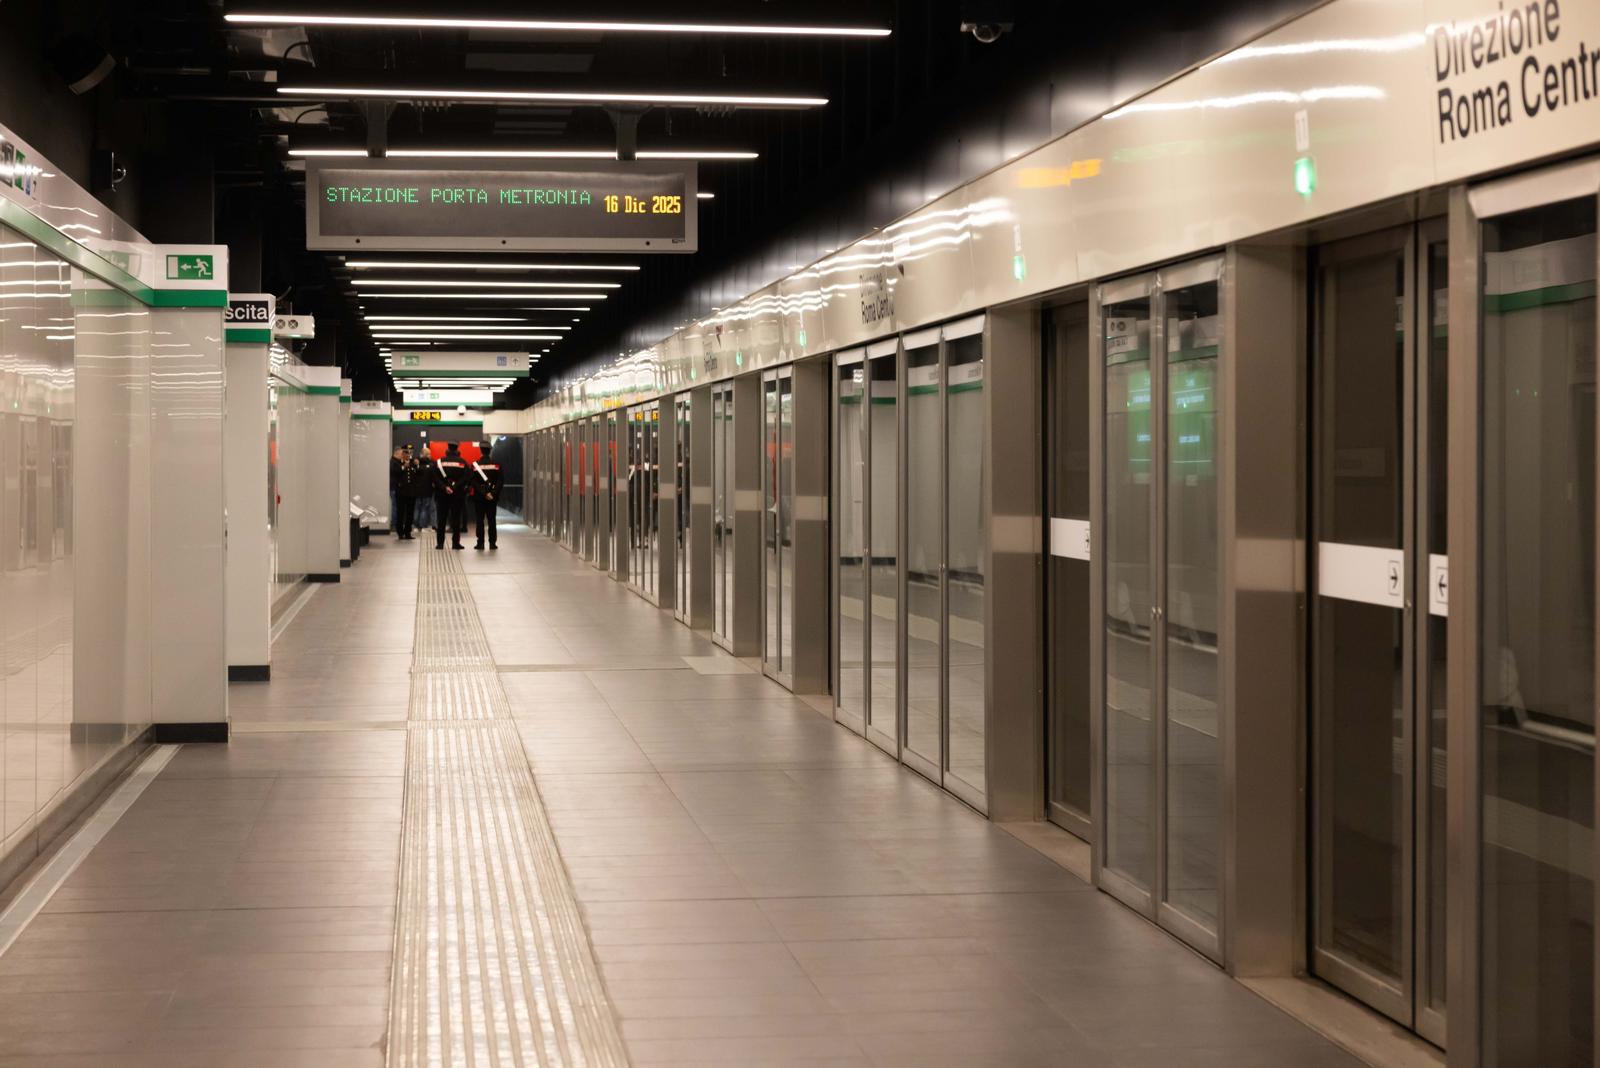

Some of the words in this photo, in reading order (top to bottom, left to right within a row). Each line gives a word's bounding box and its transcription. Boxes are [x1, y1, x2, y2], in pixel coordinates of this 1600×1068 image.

[1434, 0, 1560, 82] Direzione
[1438, 80, 1512, 143] Roma
[1521, 42, 1600, 117] Centr
[326, 187, 419, 203] STAZIONE
[431, 188, 488, 204] PORTA
[499, 189, 591, 205] METRONIA
[603, 195, 619, 213] 16
[625, 195, 646, 213] Dic
[652, 195, 681, 214] 2025
[225, 304, 268, 320] scita
